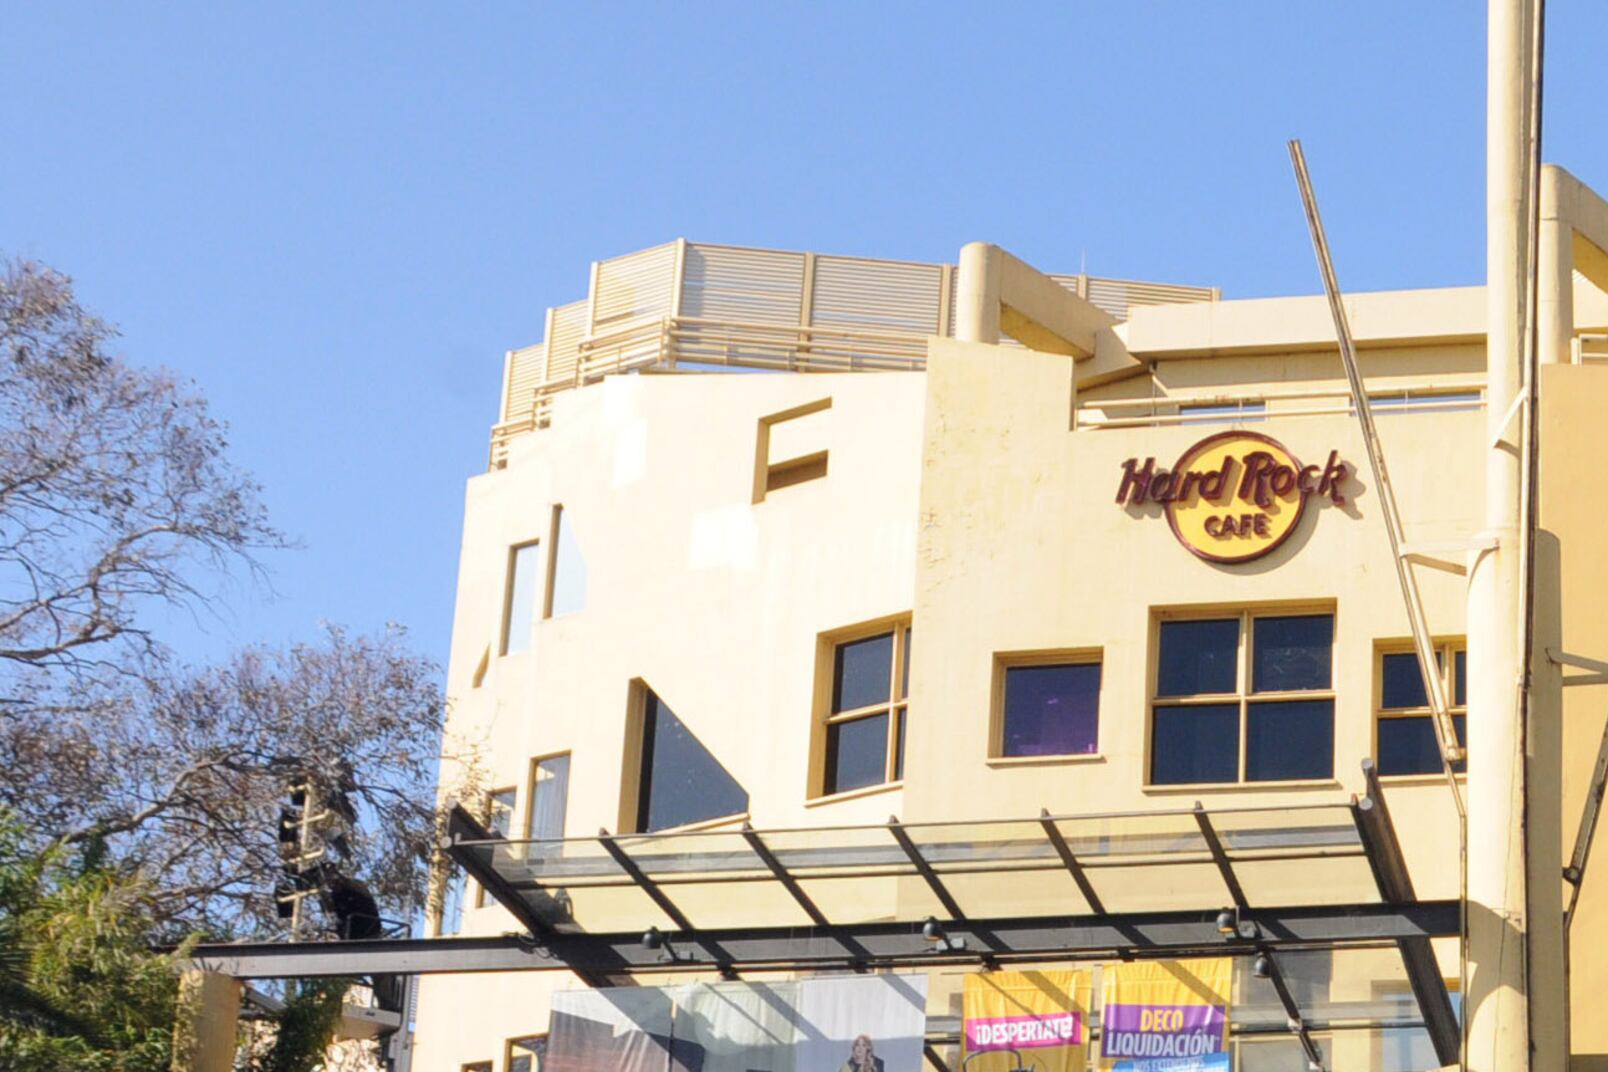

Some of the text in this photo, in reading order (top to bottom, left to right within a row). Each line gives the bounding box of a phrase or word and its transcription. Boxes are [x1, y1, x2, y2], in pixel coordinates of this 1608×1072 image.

[1115, 449, 1346, 509] Hard Rock
[1203, 513, 1270, 538] CAFE
[1140, 1008, 1185, 1032] DECO
[1106, 1029, 1216, 1057] LIQUIDACIÓN
